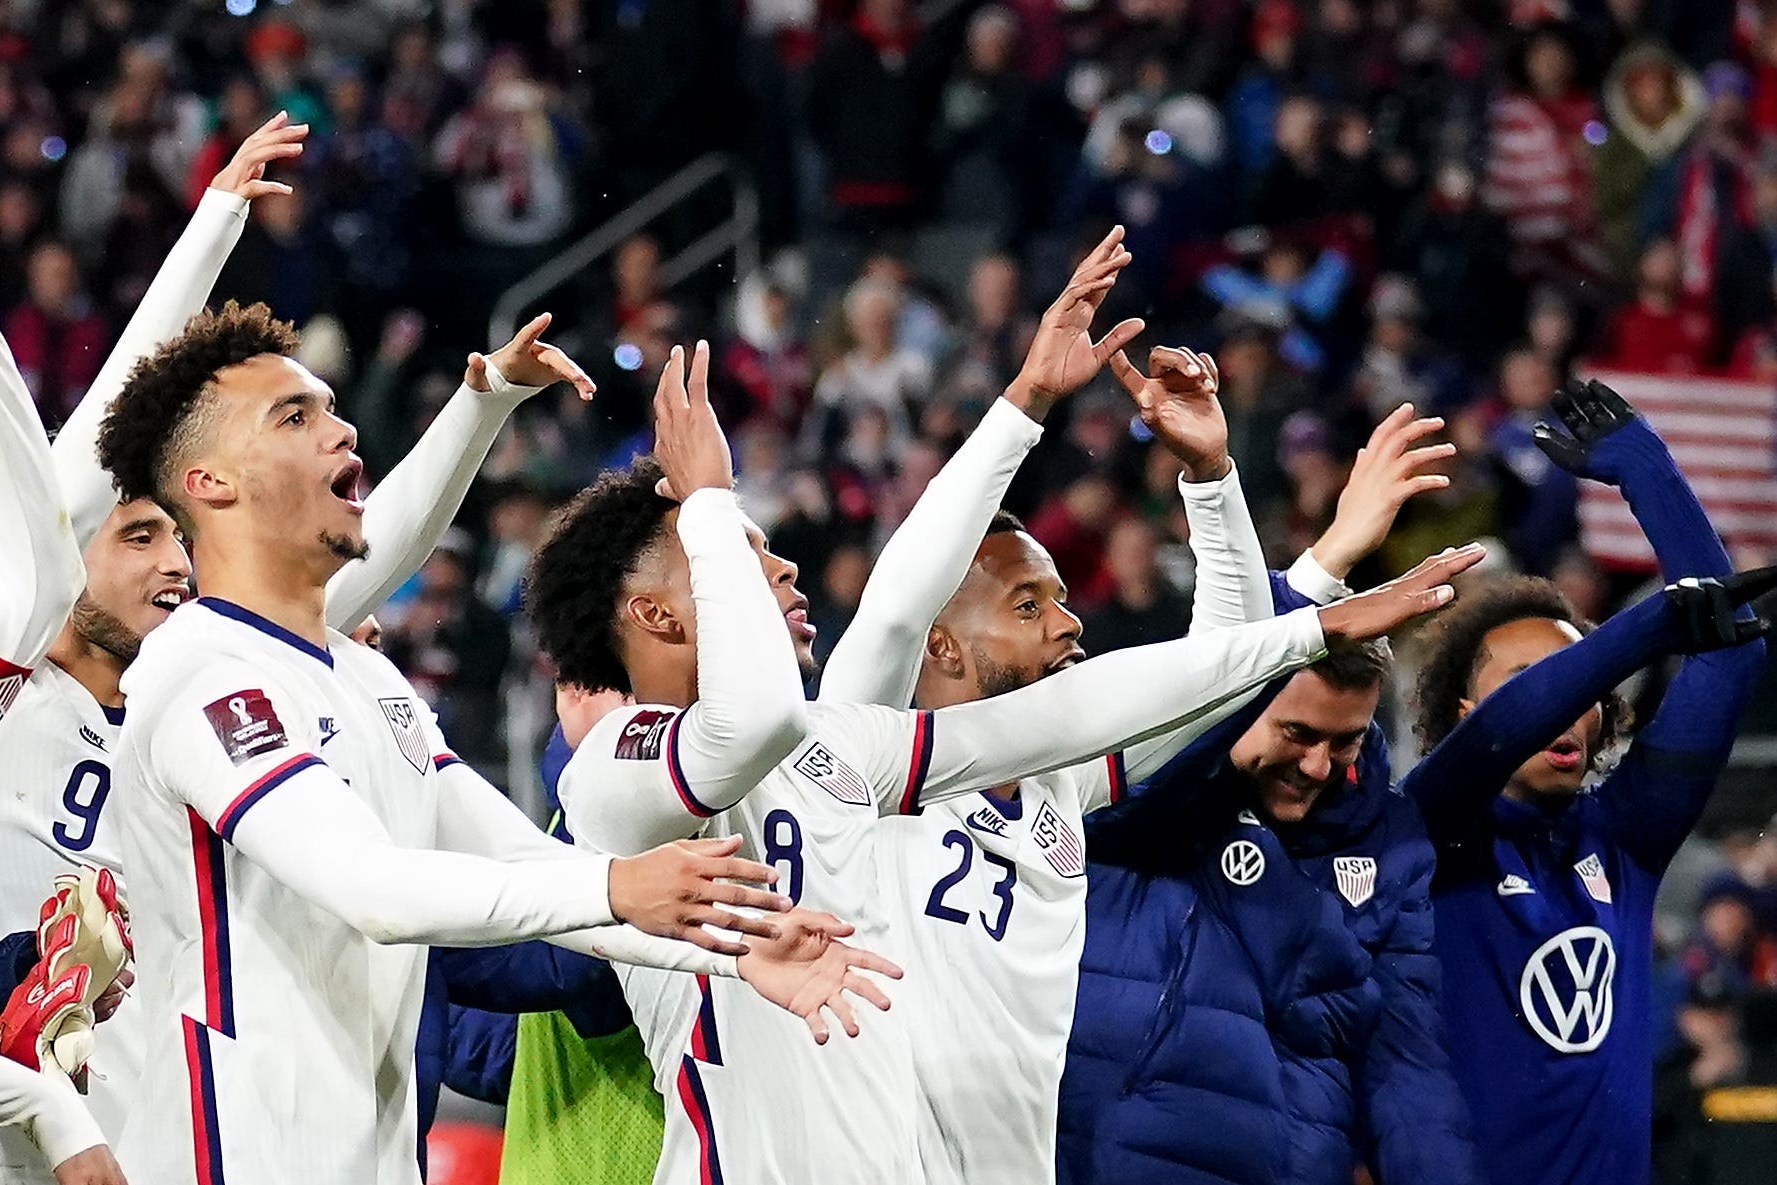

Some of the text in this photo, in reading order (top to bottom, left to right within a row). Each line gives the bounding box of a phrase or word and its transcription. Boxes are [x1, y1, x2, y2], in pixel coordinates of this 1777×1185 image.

[384, 703, 414, 729] USA
[802, 748, 834, 778] USA
[52, 759, 111, 852] 9
[976, 807, 999, 832] NIKE
[1033, 809, 1059, 850] USA
[763, 809, 804, 911] 8
[1336, 860, 1373, 875] USA
[924, 829, 1018, 942] 23
[1526, 930, 1614, 1049] VW
